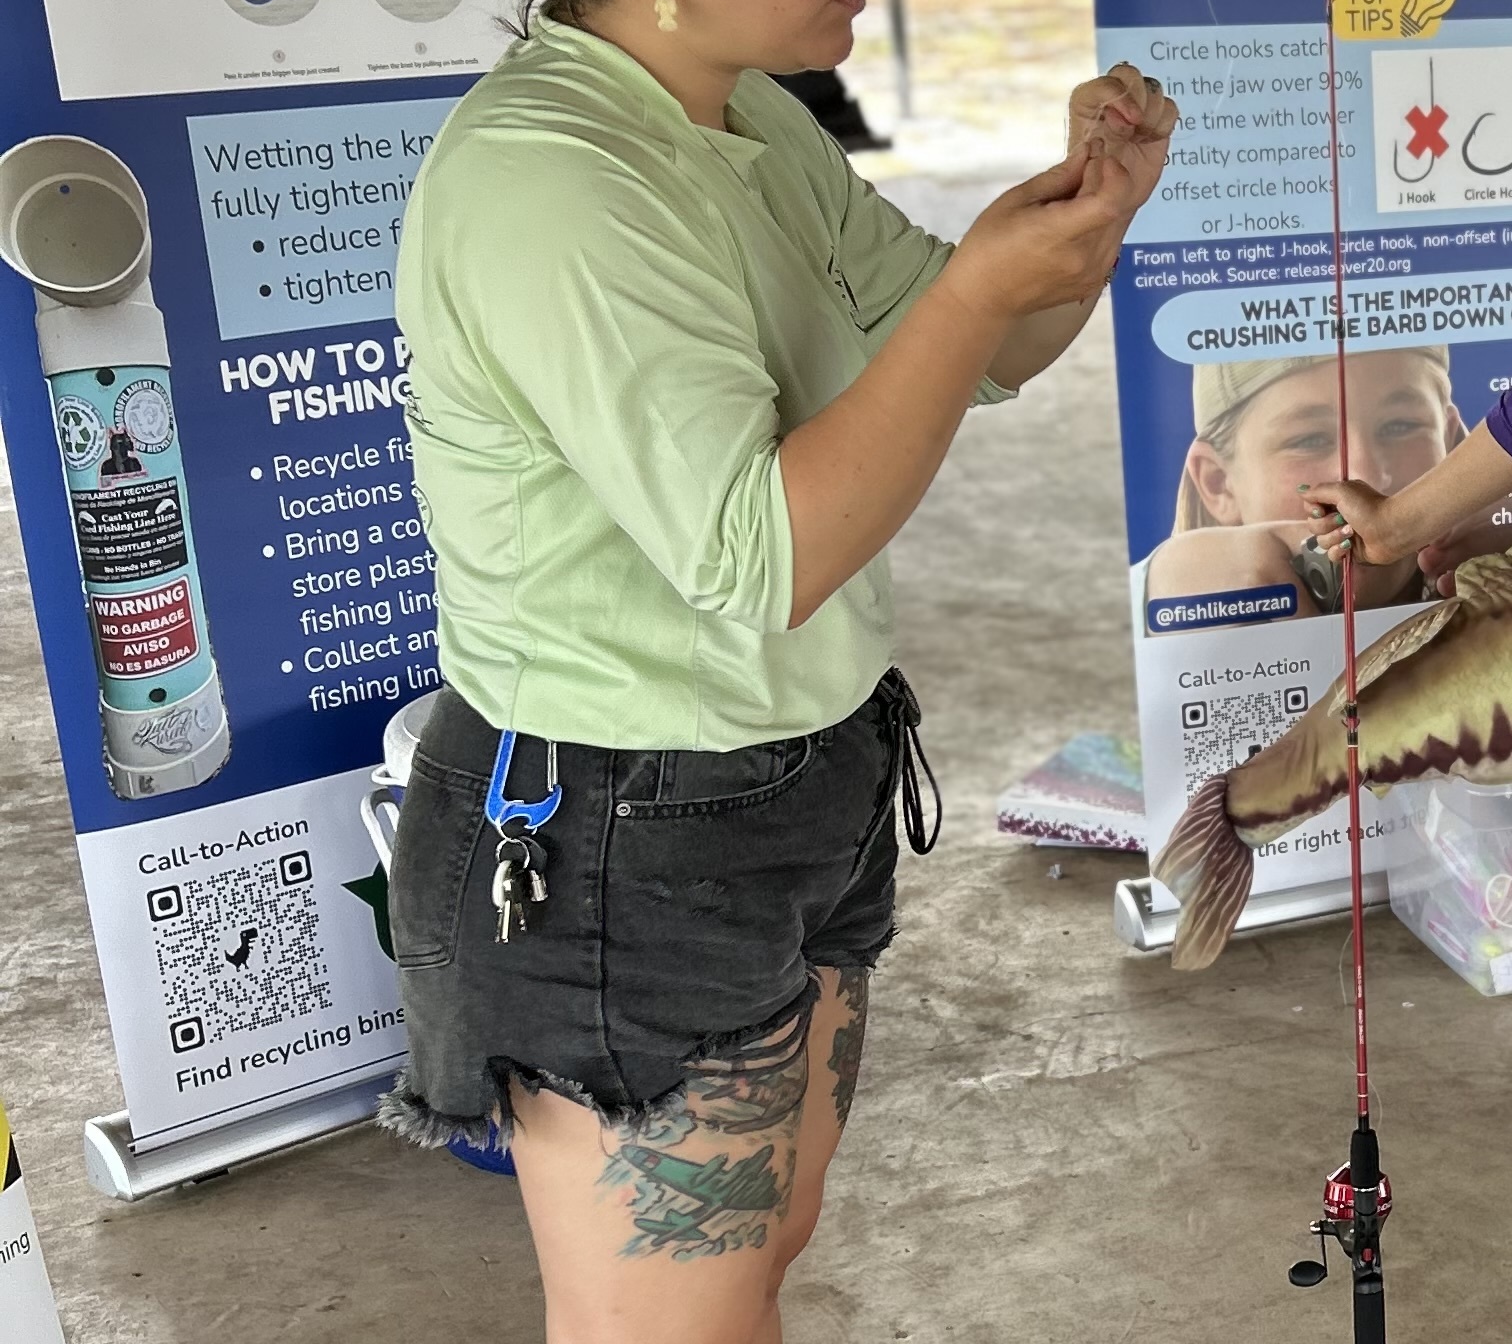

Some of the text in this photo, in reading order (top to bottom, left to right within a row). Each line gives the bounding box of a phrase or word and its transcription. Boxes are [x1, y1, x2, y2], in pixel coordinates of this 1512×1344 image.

[1346, 11, 1393, 33] TIPS
[1150, 36, 1330, 62] Circle hooks catch
[1167, 71, 1363, 99] in the jaw over 90%
[1202, 109, 1244, 131] time
[1250, 107, 1293, 128] with
[1301, 106, 1354, 128] lower
[204, 134, 392, 172] Wetting the
[1237, 139, 1356, 166] compared to
[211, 174, 415, 220] fully tighteni
[1161, 174, 1335, 201] offset circle hooks
[1406, 189, 1436, 205] Hook
[1465, 187, 1497, 201] Circle
[1202, 211, 1305, 235] or J-hooks.
[279, 226, 381, 256] reduce
[1134, 249, 1176, 266] From
[1183, 247, 1208, 264] left
[1215, 247, 1230, 262] to
[1236, 244, 1274, 265] right:
[1281, 240, 1332, 259] J-hook,
[1340, 237, 1374, 253] circle
[1380, 234, 1417, 253] hook,
[1423, 229, 1496, 248] non-offset
[284, 270, 392, 304] tighten
[1135, 255, 1411, 288] circle Source: releaseover20.org
[1242, 297, 1316, 321] WHAT
[1322, 294, 1347, 316] IS
[1348, 292, 1394, 313] THE
[1187, 321, 1306, 351] CRUSHING
[1312, 316, 1361, 342] THE
[1368, 311, 1427, 336] BARB
[1433, 304, 1503, 331] DOWN
[220, 348, 316, 392] HOW
[325, 340, 384, 376] TO
[269, 375, 412, 424] FISHING
[273, 444, 379, 481] Recycle
[124, 510, 148, 520] Your
[279, 482, 402, 520] locations
[98, 522, 133, 533] Fishing
[135, 519, 155, 528] Line
[286, 528, 359, 560] Bring
[368, 525, 382, 544] a
[292, 567, 361, 597] store
[95, 585, 184, 617] WARNING
[299, 599, 392, 635] fishing
[1156, 593, 1290, 626] @fishliketarzan
[102, 609, 185, 636] NO GARBAGE
[110, 645, 190, 672] NO ES BASURA
[124, 636, 170, 657] AVISO
[304, 633, 400, 674] Collect
[1178, 657, 1310, 690] Call-to-Action
[309, 674, 399, 712] fishing
[139, 818, 309, 875] Call-to-Action
[1258, 829, 1341, 857] the right
[176, 1007, 406, 1092] Find recycling bins
[0, 1231, 31, 1264] ing
